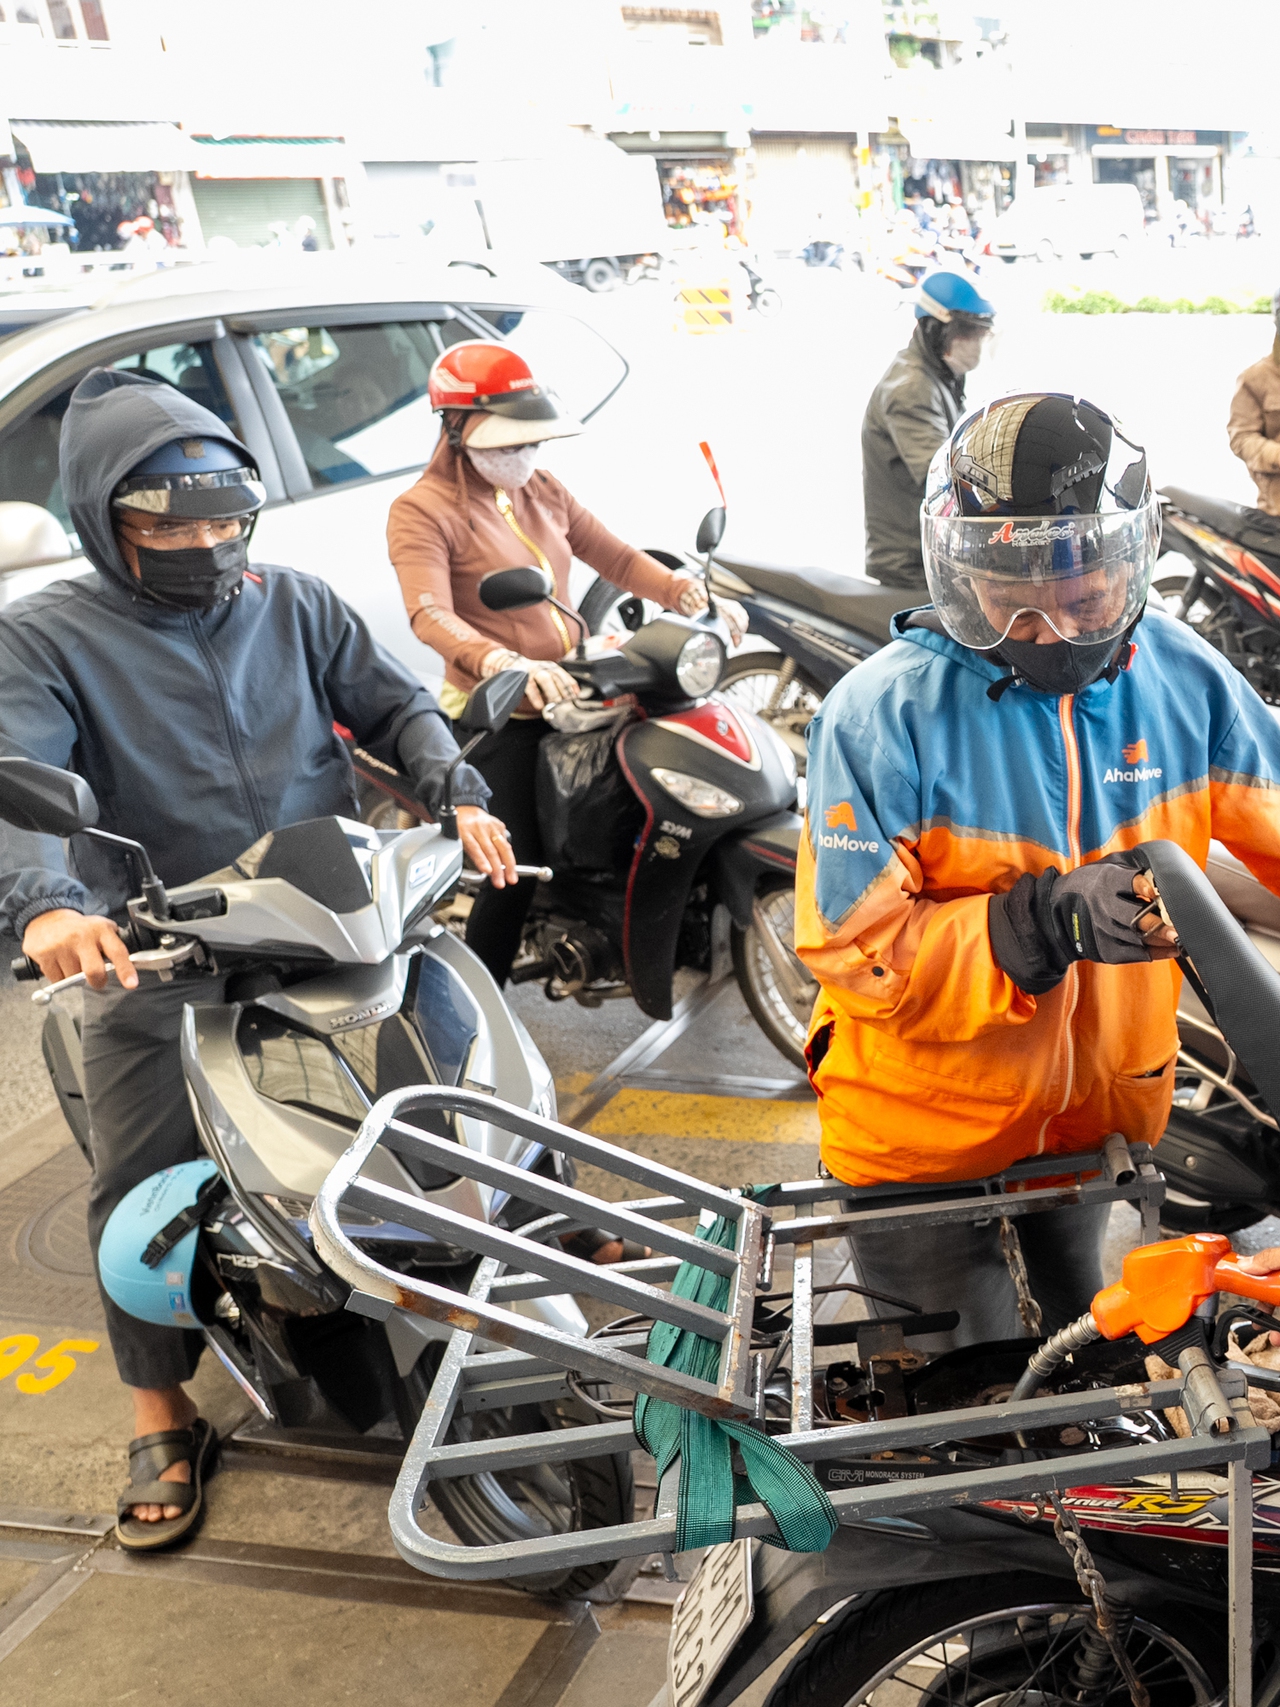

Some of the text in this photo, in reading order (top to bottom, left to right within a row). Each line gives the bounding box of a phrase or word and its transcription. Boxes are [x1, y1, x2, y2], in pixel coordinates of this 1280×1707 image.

[819, 829, 879, 854] haMove
[231, 1254, 259, 1269] 125
[0, 1333, 99, 1394] 95
[865, 1471, 899, 1479] MONORACK
[901, 1471, 925, 1479] SYSTEM
